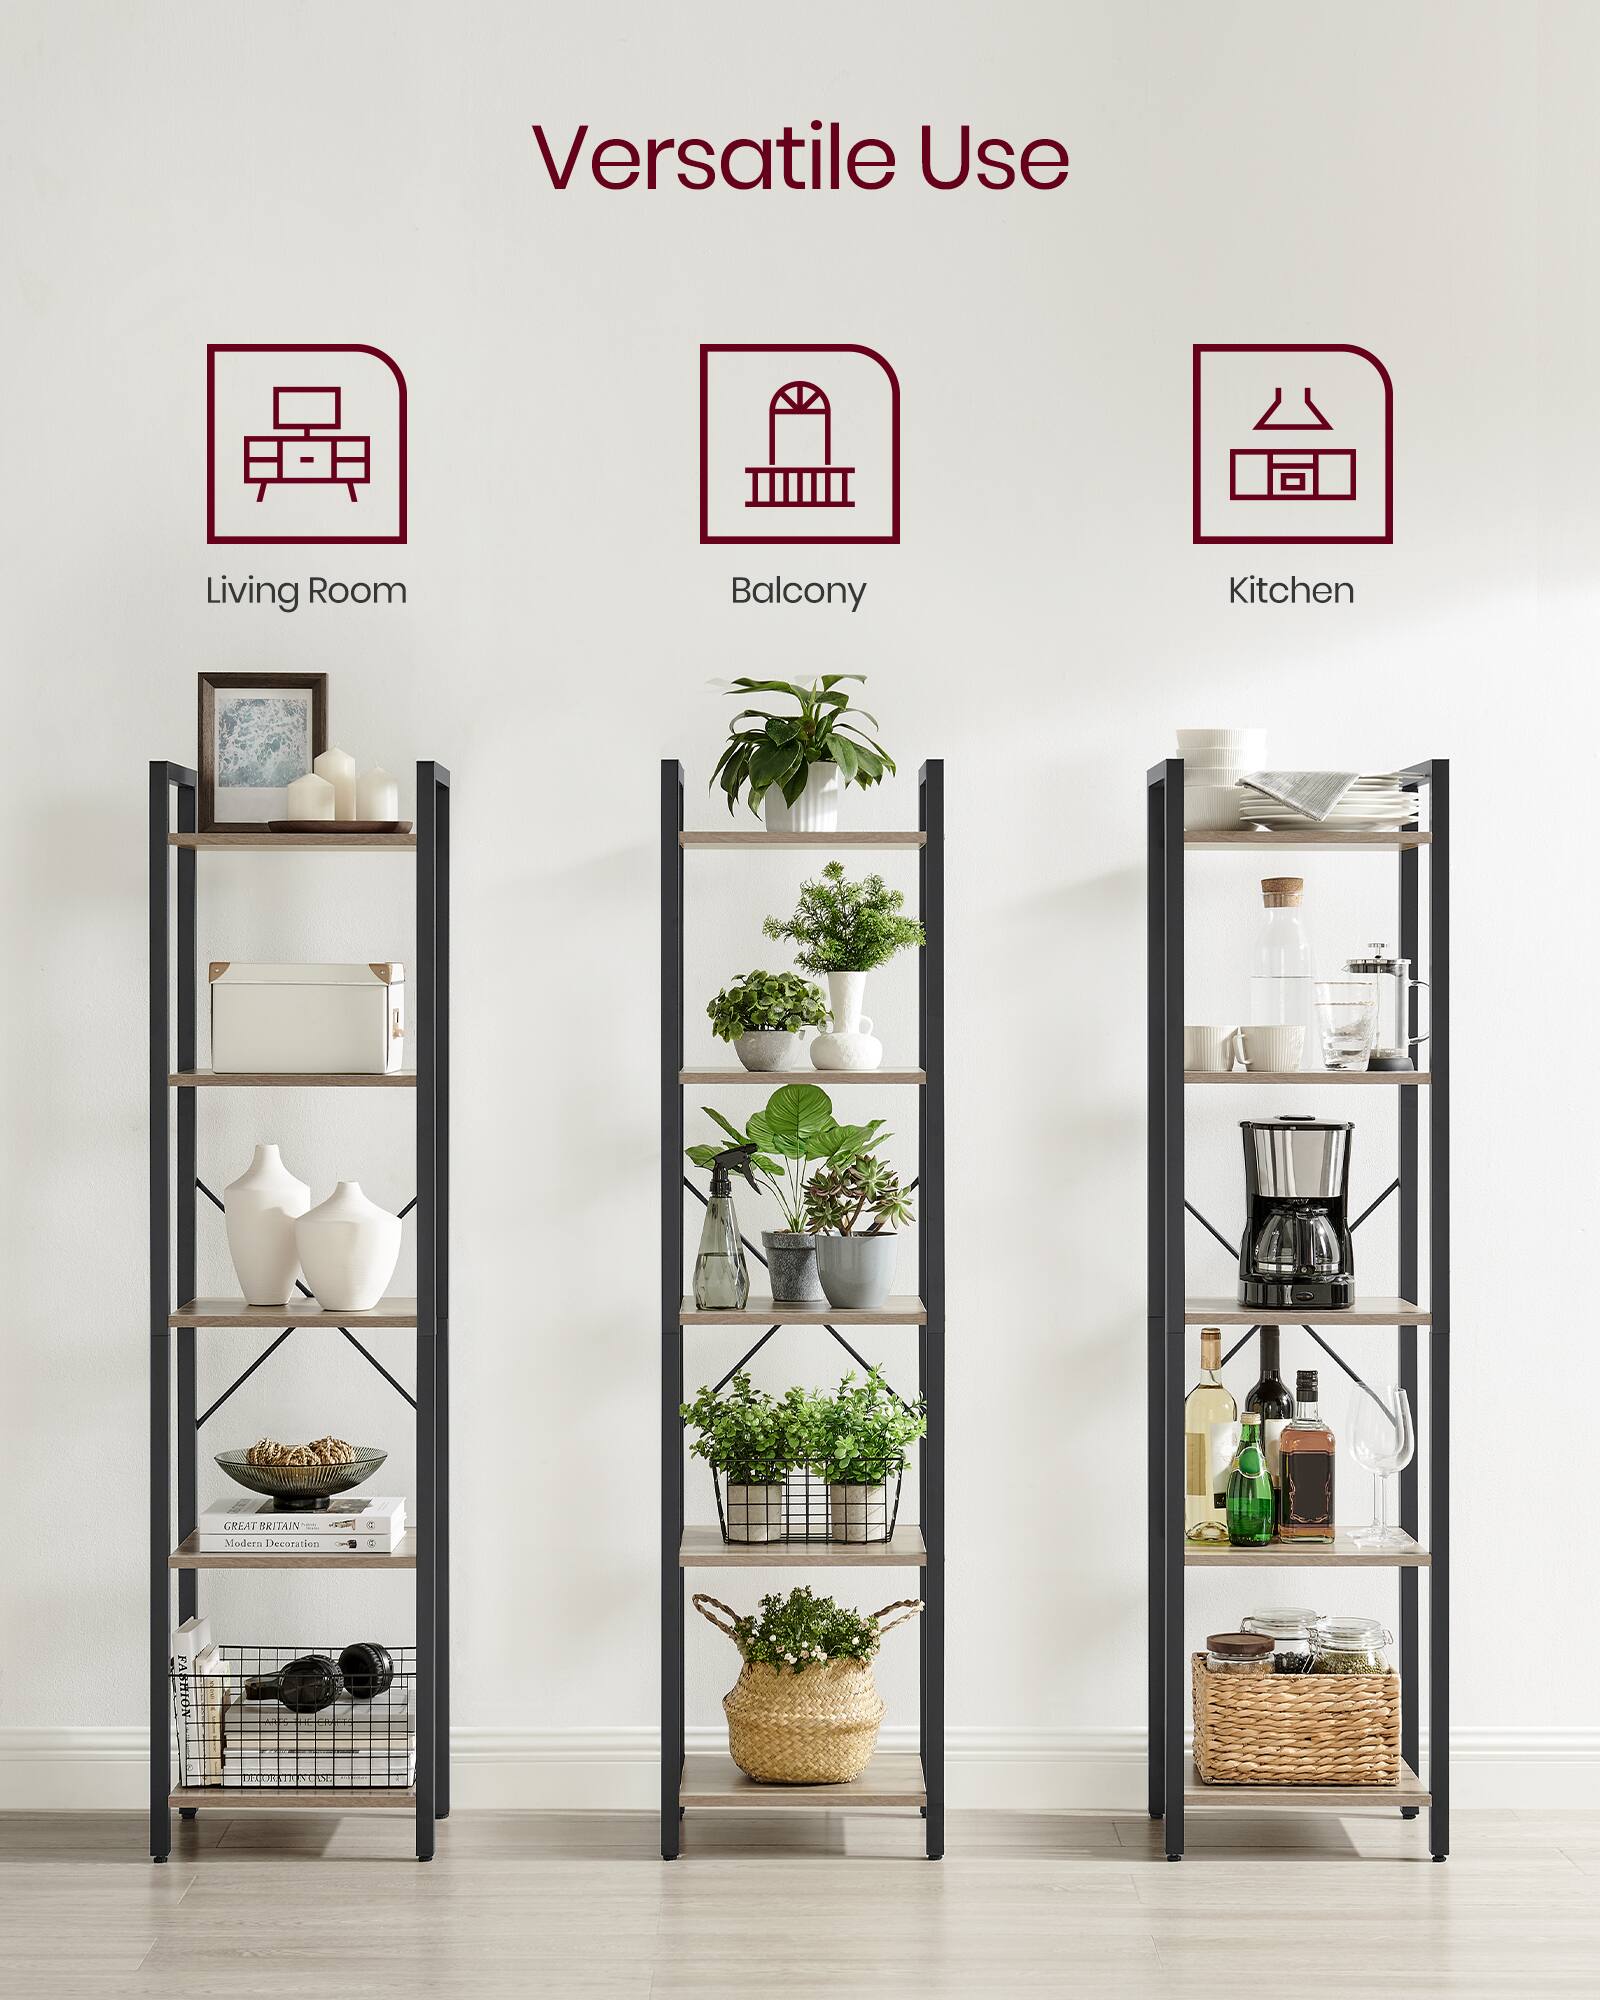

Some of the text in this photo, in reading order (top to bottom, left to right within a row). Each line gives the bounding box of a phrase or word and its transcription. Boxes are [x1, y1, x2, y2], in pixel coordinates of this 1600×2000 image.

[223, 1521, 257, 1531] GREAT
[258, 1521, 300, 1531] BRITAIN
[224, 1538, 320, 1549] Modern Decoration
[177, 1655, 191, 1718] FASHION
